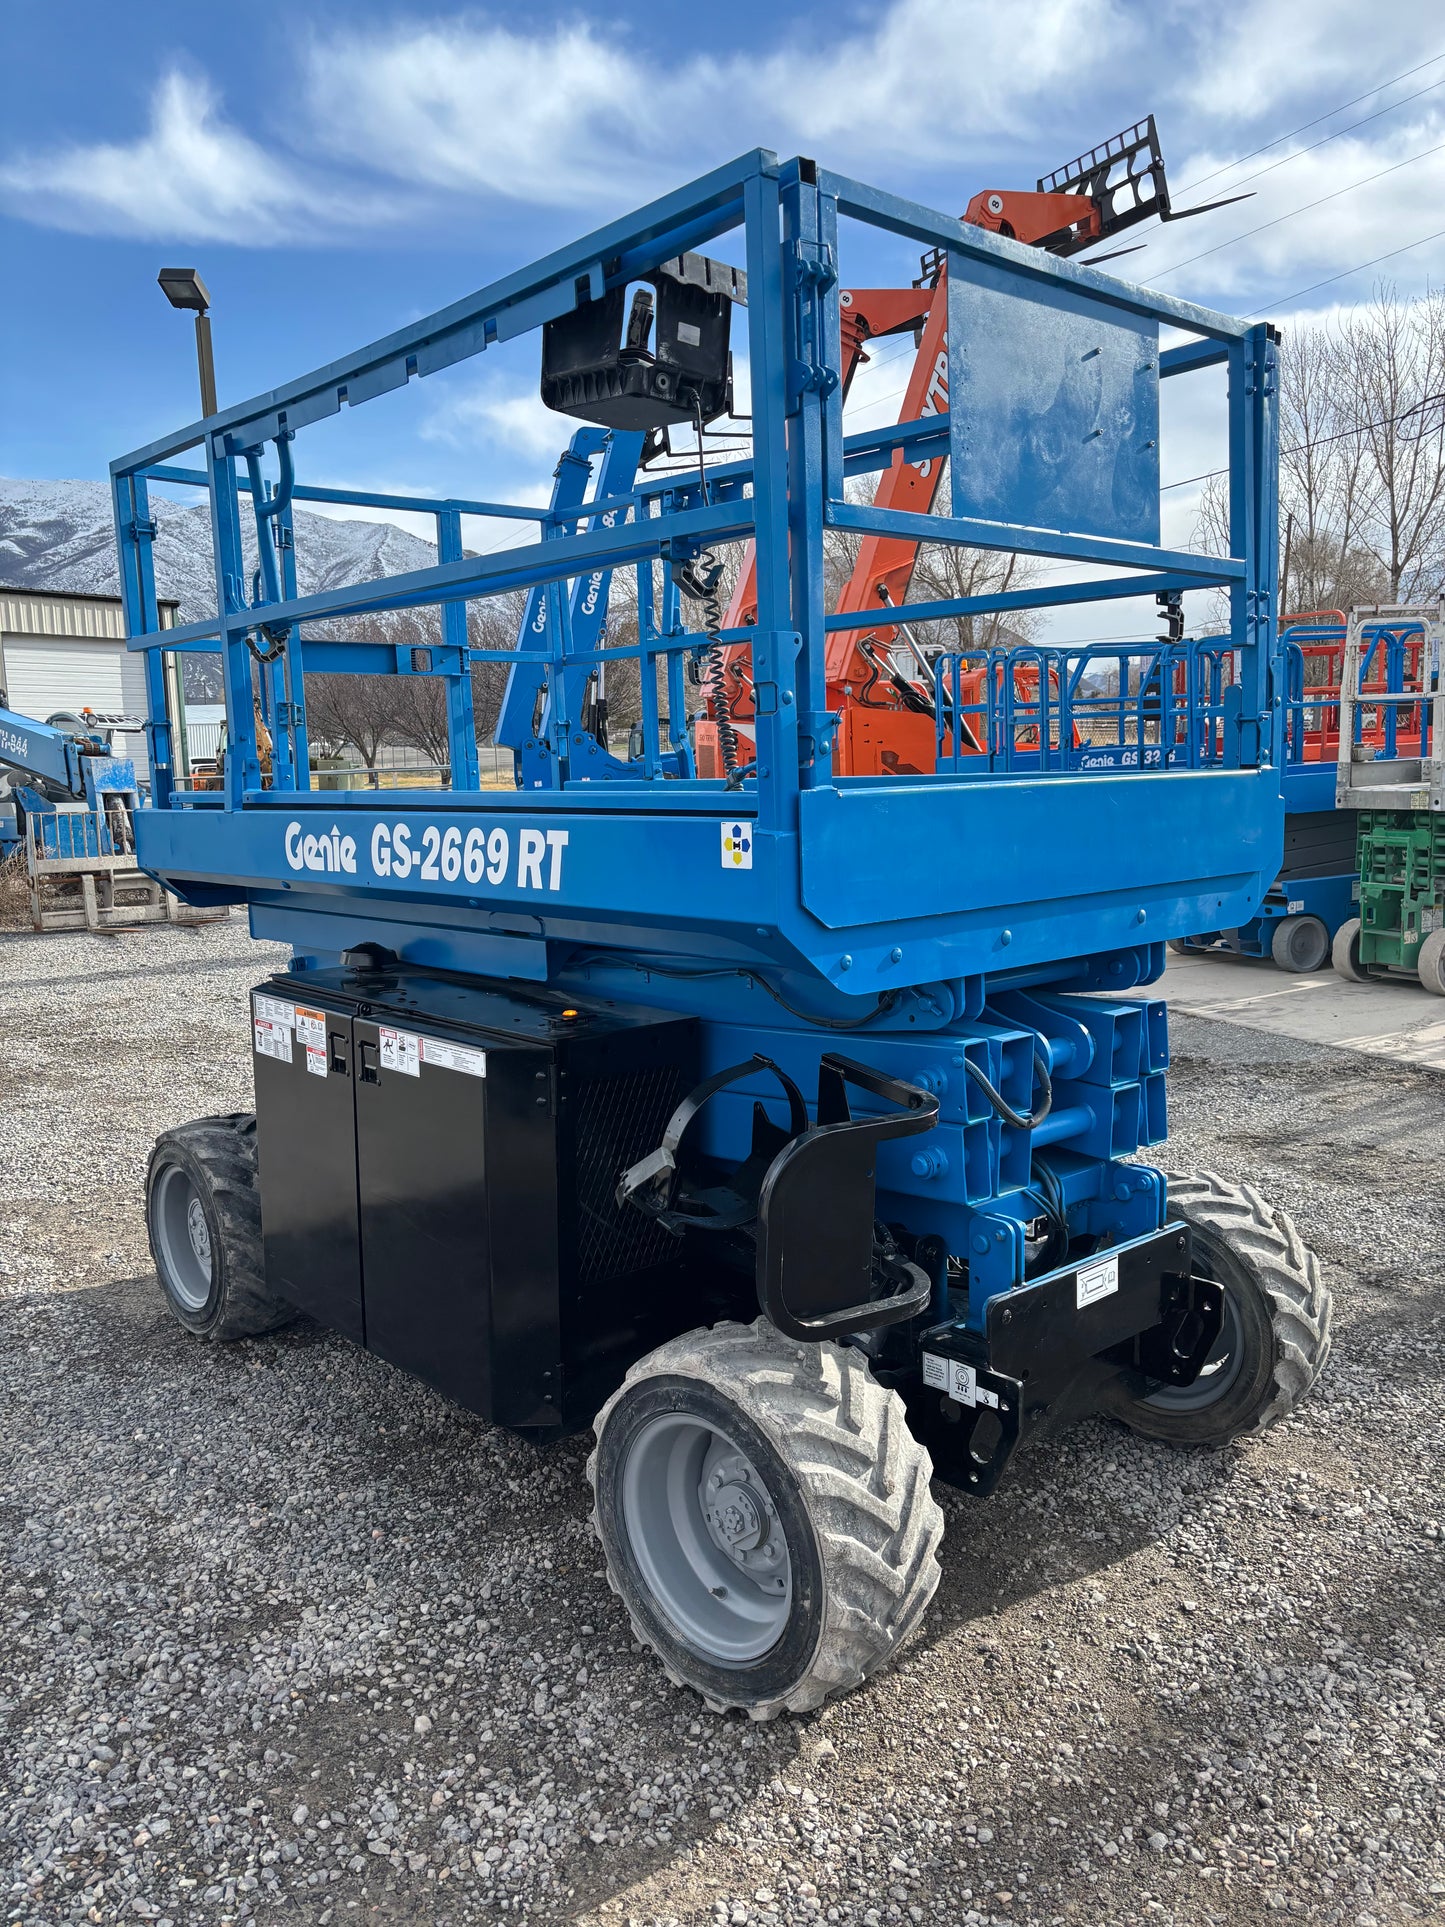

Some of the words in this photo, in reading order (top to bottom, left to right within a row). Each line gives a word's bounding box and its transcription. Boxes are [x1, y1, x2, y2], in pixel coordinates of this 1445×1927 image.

[532, 594, 547, 633] Geni
[285, 821, 357, 874] Genie
[371, 822, 509, 885] GS-2669
[517, 828, 569, 891] RT
